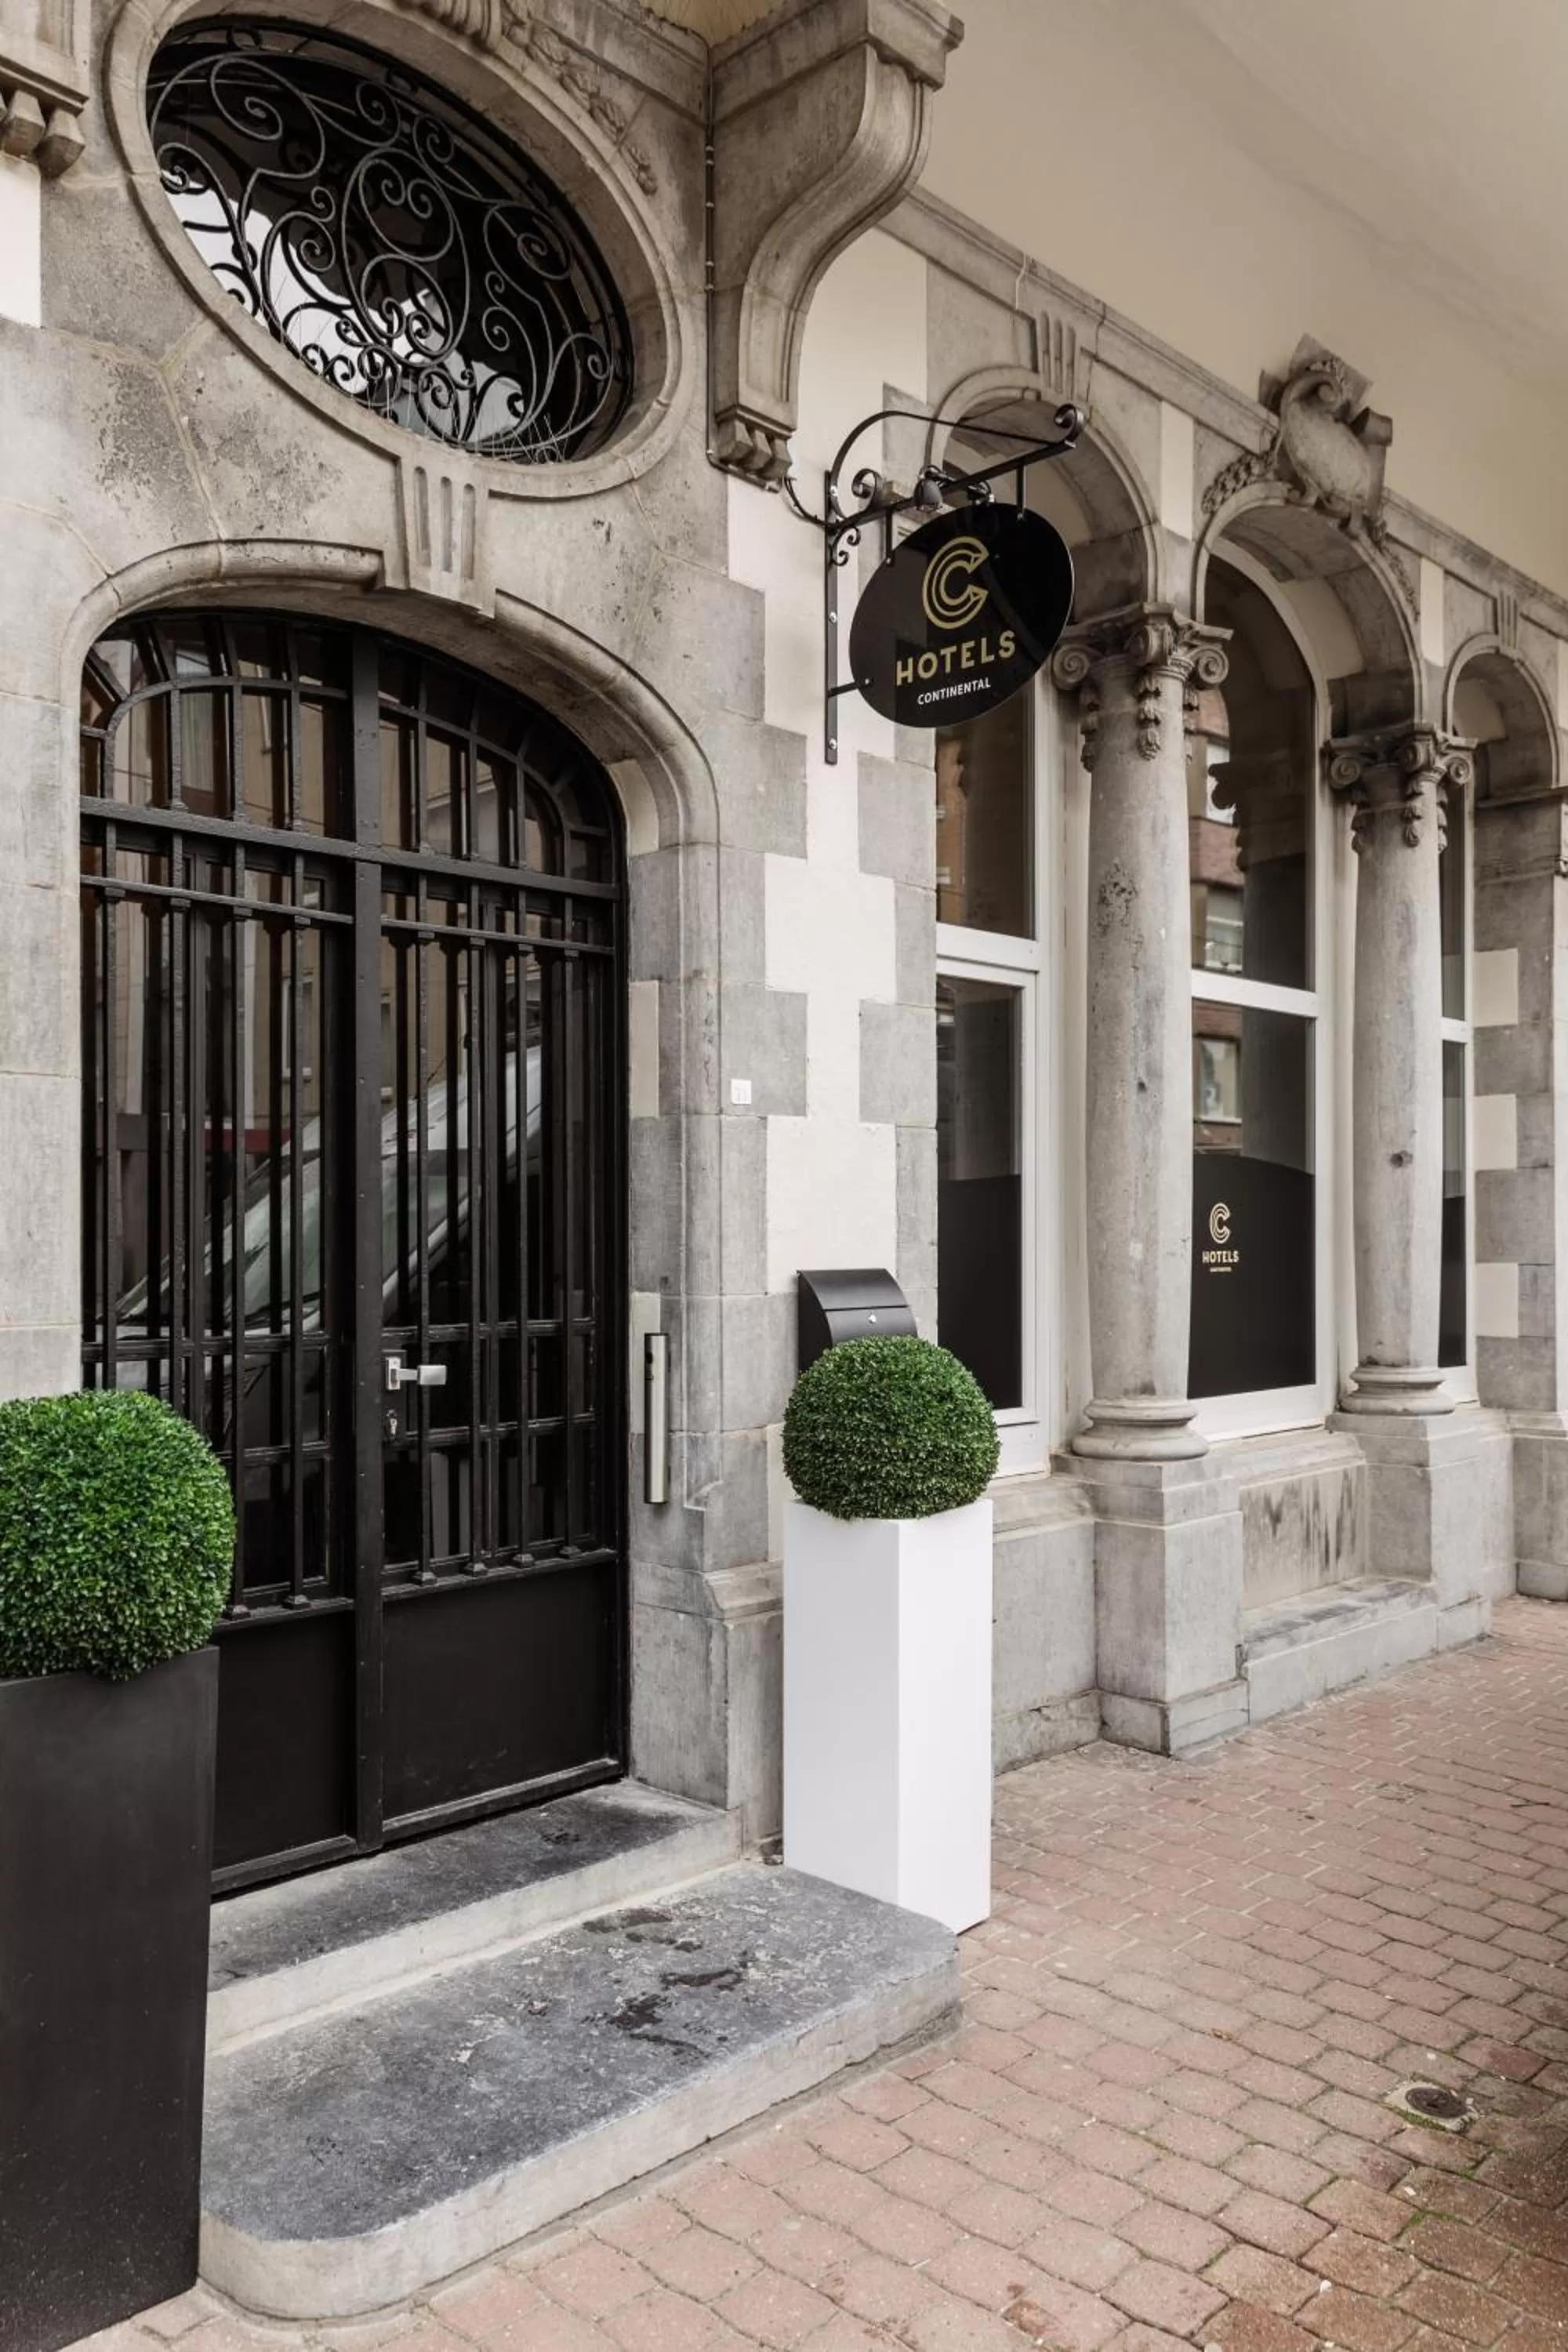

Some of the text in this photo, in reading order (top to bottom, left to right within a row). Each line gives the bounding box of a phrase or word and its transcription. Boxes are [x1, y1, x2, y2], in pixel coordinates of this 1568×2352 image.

[923, 536, 989, 629] C
[895, 630, 1016, 686] HOTELS
[916, 677, 991, 705] CONTINENTAL
[1210, 1203, 1231, 1243] C
[1202, 1250, 1240, 1263] HOTELS
